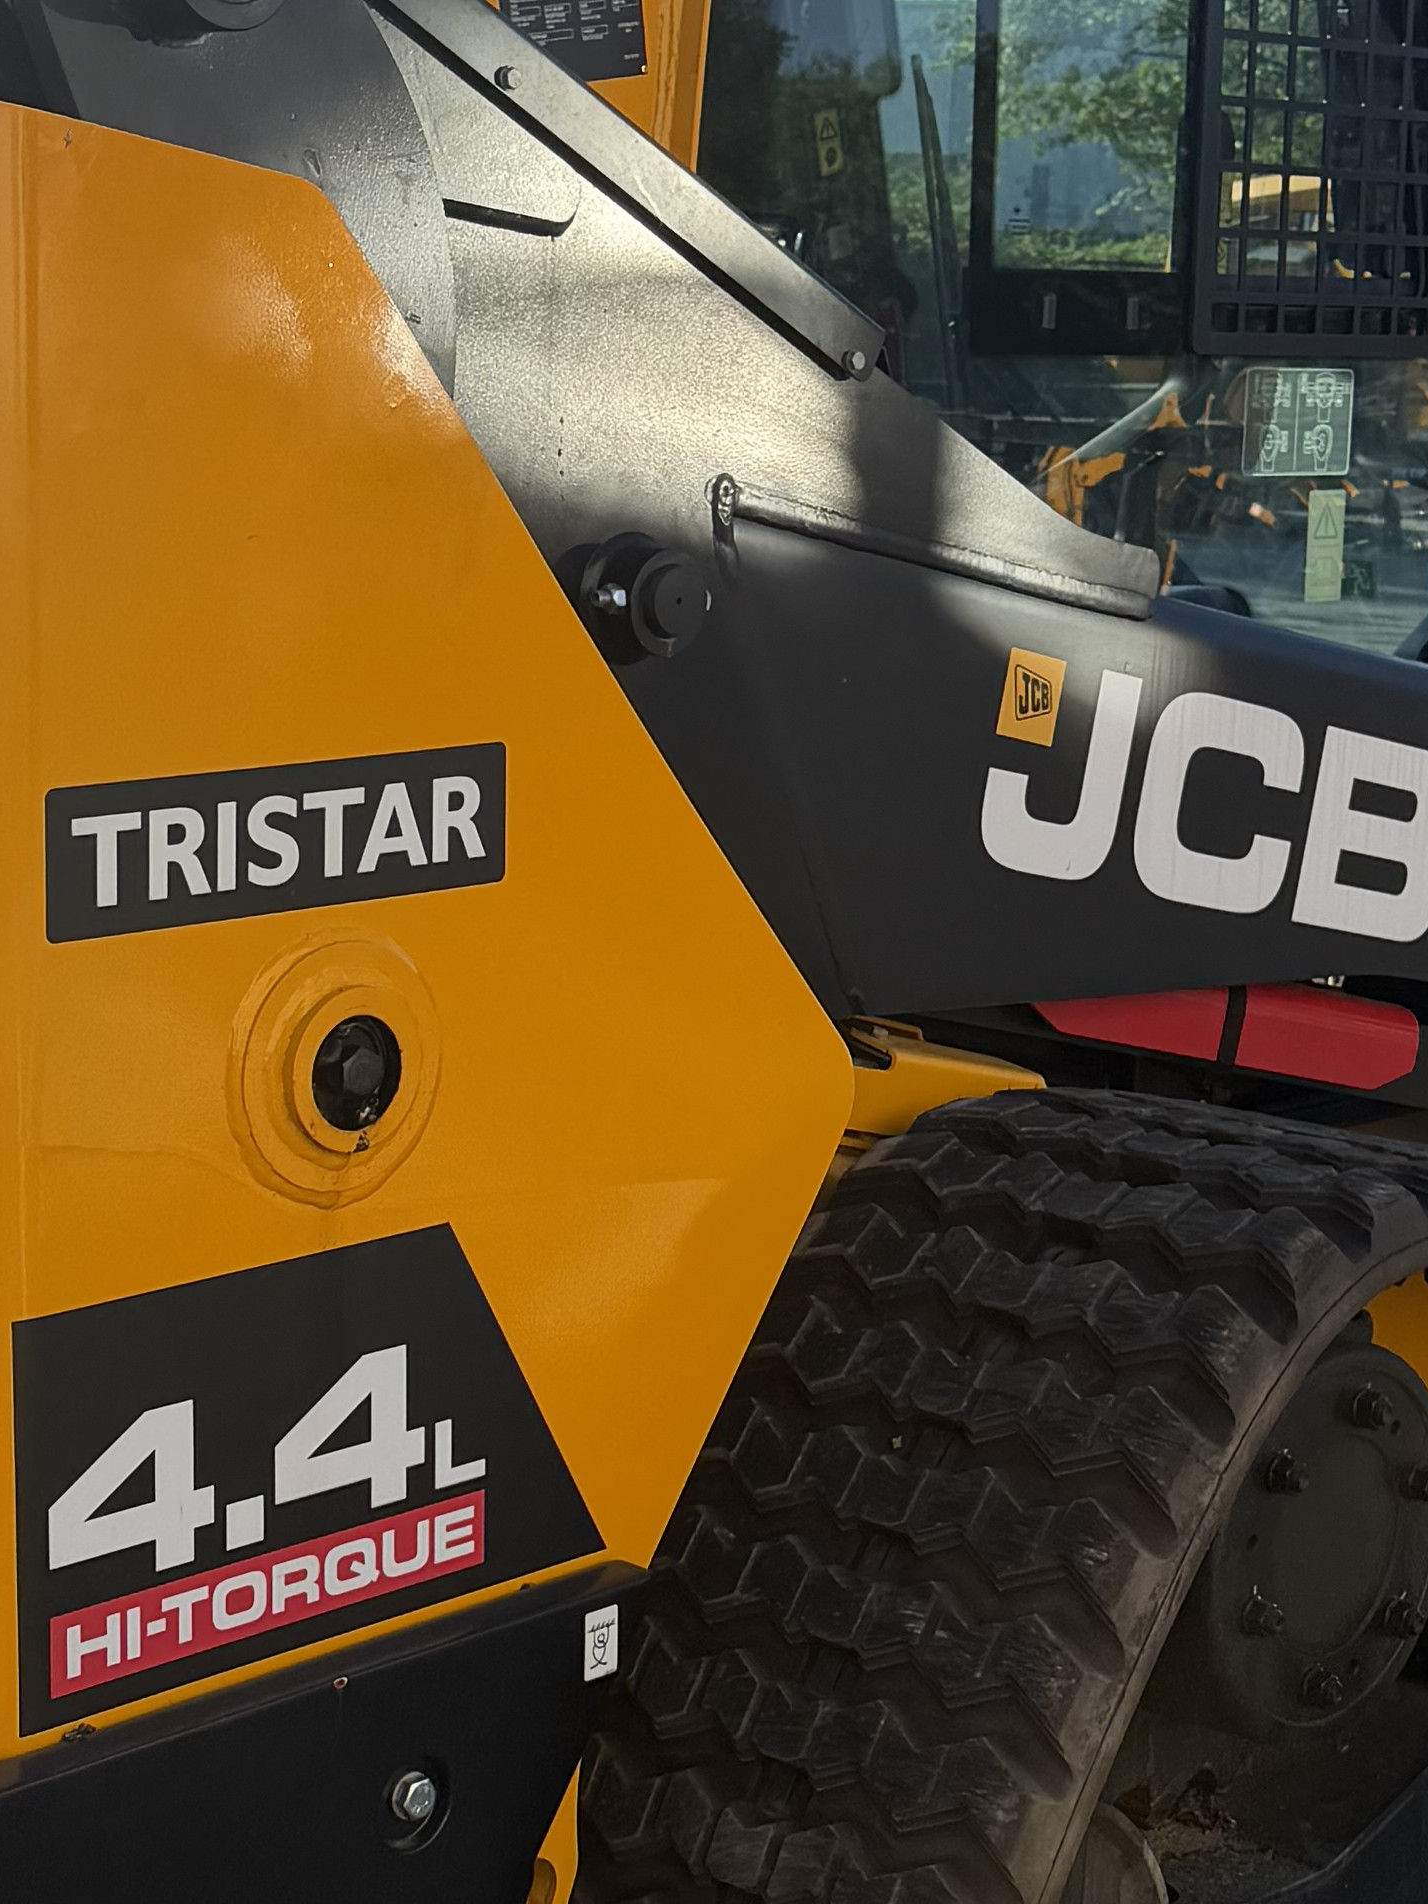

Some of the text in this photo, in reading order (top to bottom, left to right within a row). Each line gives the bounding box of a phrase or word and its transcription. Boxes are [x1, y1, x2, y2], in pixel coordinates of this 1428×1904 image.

[1019, 671, 1049, 715] JCB
[71, 775, 486, 908] TRISTAR
[48, 1343, 486, 1572] 4.4L
[66, 1505, 475, 1680] HI-TORQUE
